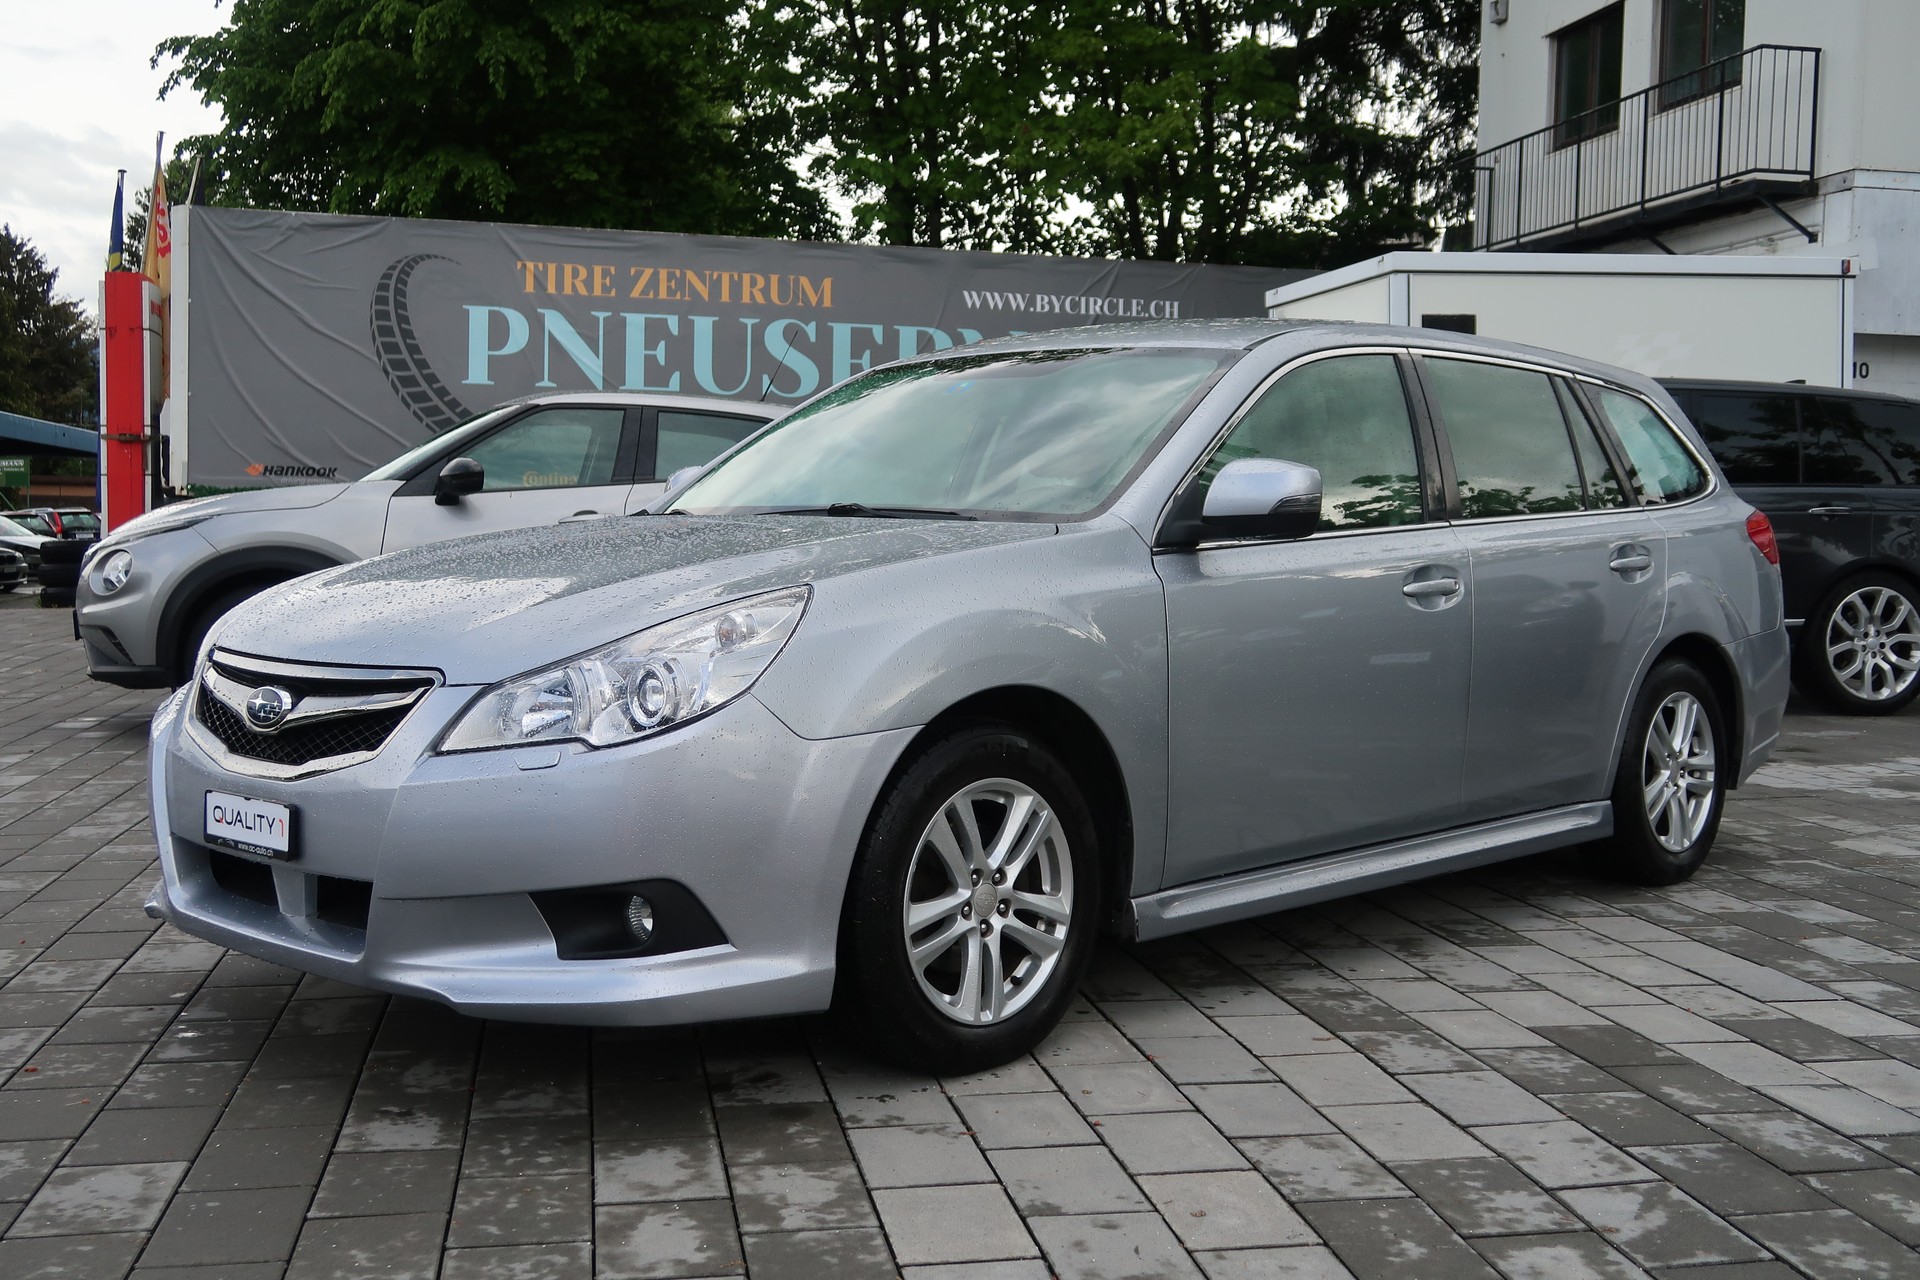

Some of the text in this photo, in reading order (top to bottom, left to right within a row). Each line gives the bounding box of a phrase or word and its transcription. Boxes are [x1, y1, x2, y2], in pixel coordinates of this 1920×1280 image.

[517, 260, 834, 308] TIRE ZENTRUM
[962, 290, 1180, 319] WWW.BYCIRCLE.CH
[461, 303, 1030, 399] PNEUSE
